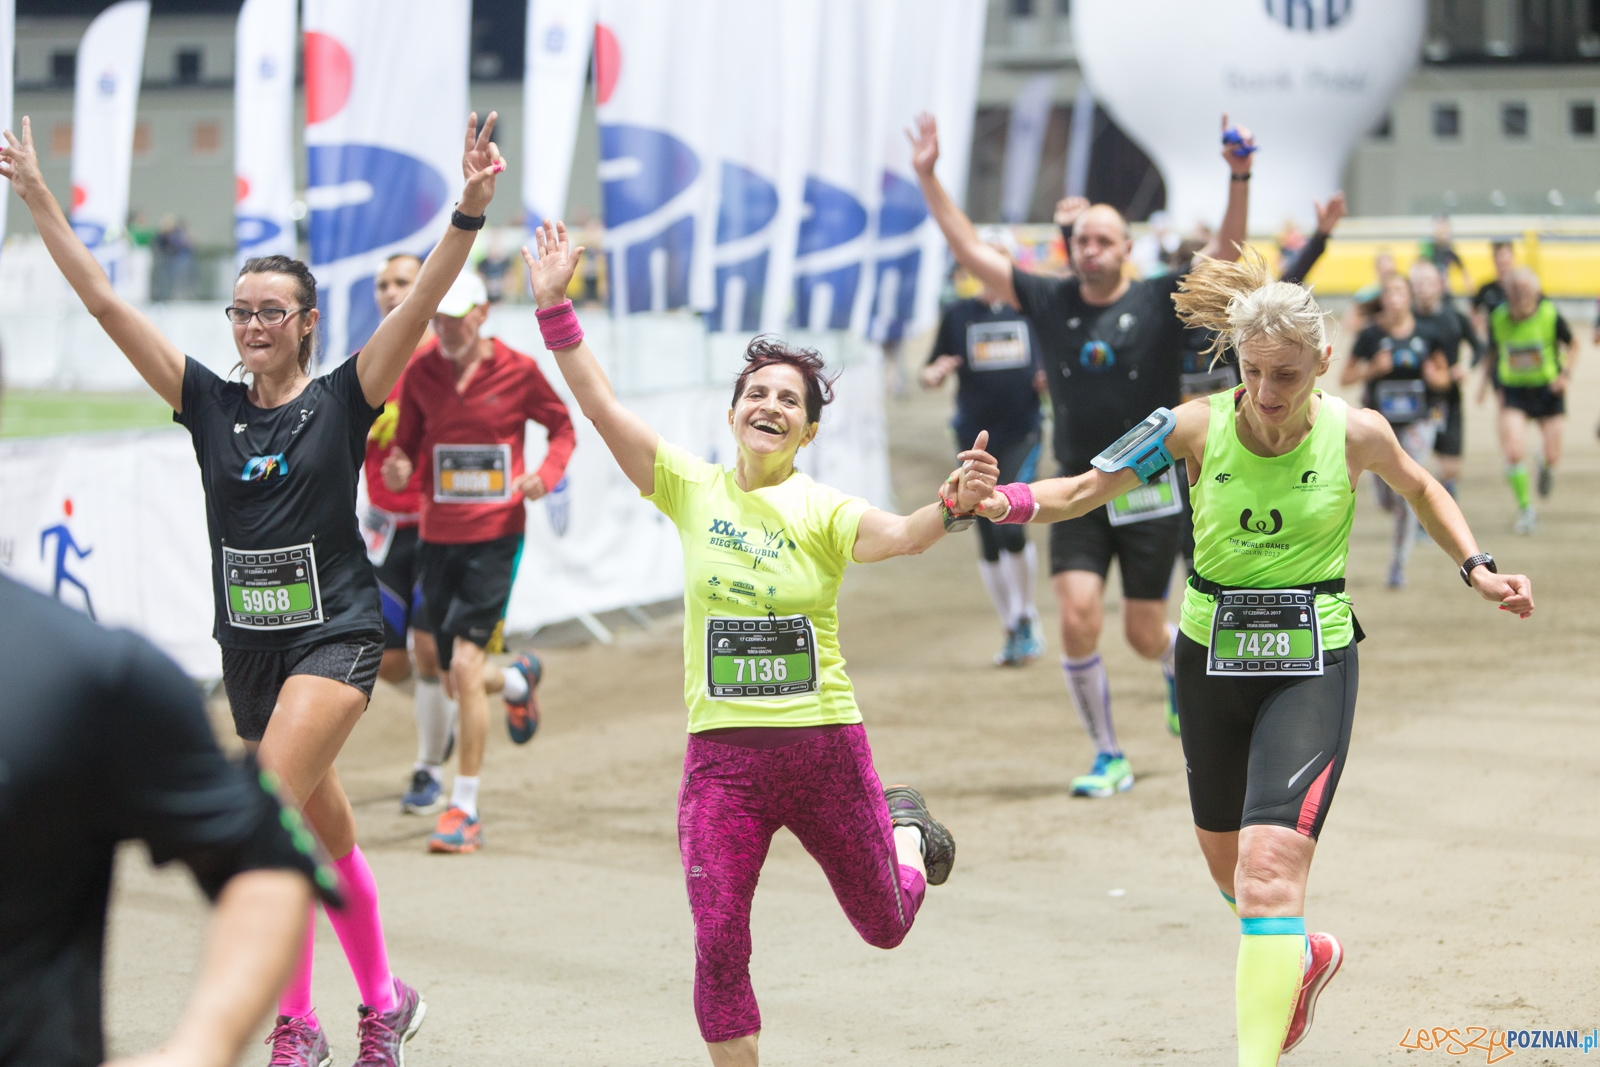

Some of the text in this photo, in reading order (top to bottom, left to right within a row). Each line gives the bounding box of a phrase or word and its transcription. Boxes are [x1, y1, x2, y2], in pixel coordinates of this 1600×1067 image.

[1215, 472, 1231, 484] 4F
[709, 537, 731, 548] BIEG
[1229, 537, 1290, 550] THE WORLD GAMES
[241, 588, 291, 613] 5968
[1234, 632, 1290, 657] 7428
[733, 657, 787, 682] 7136
